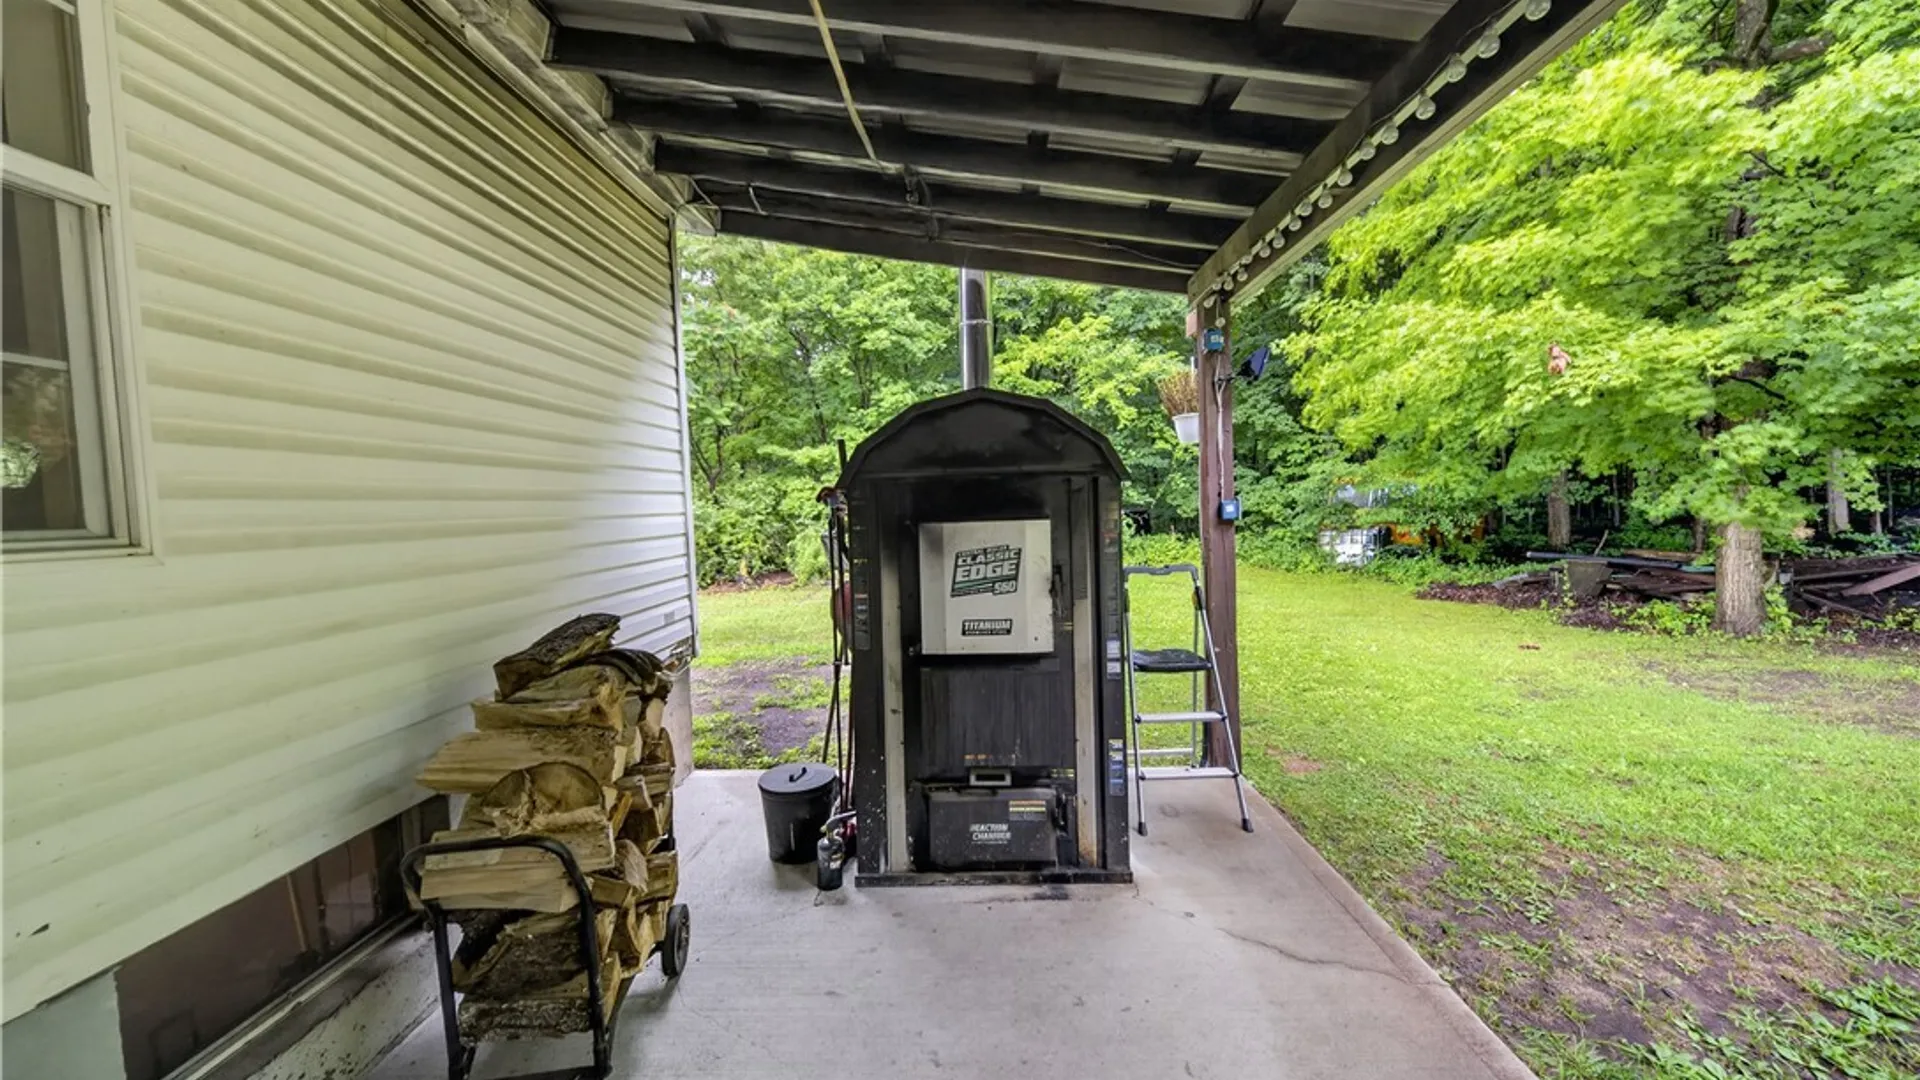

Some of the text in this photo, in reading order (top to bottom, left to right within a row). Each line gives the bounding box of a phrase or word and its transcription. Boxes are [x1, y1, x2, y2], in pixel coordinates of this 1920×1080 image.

[957, 549, 1020, 565] CLASSIC
[956, 560, 1018, 581] EDGE
[964, 620, 1010, 630] TITANIUM
